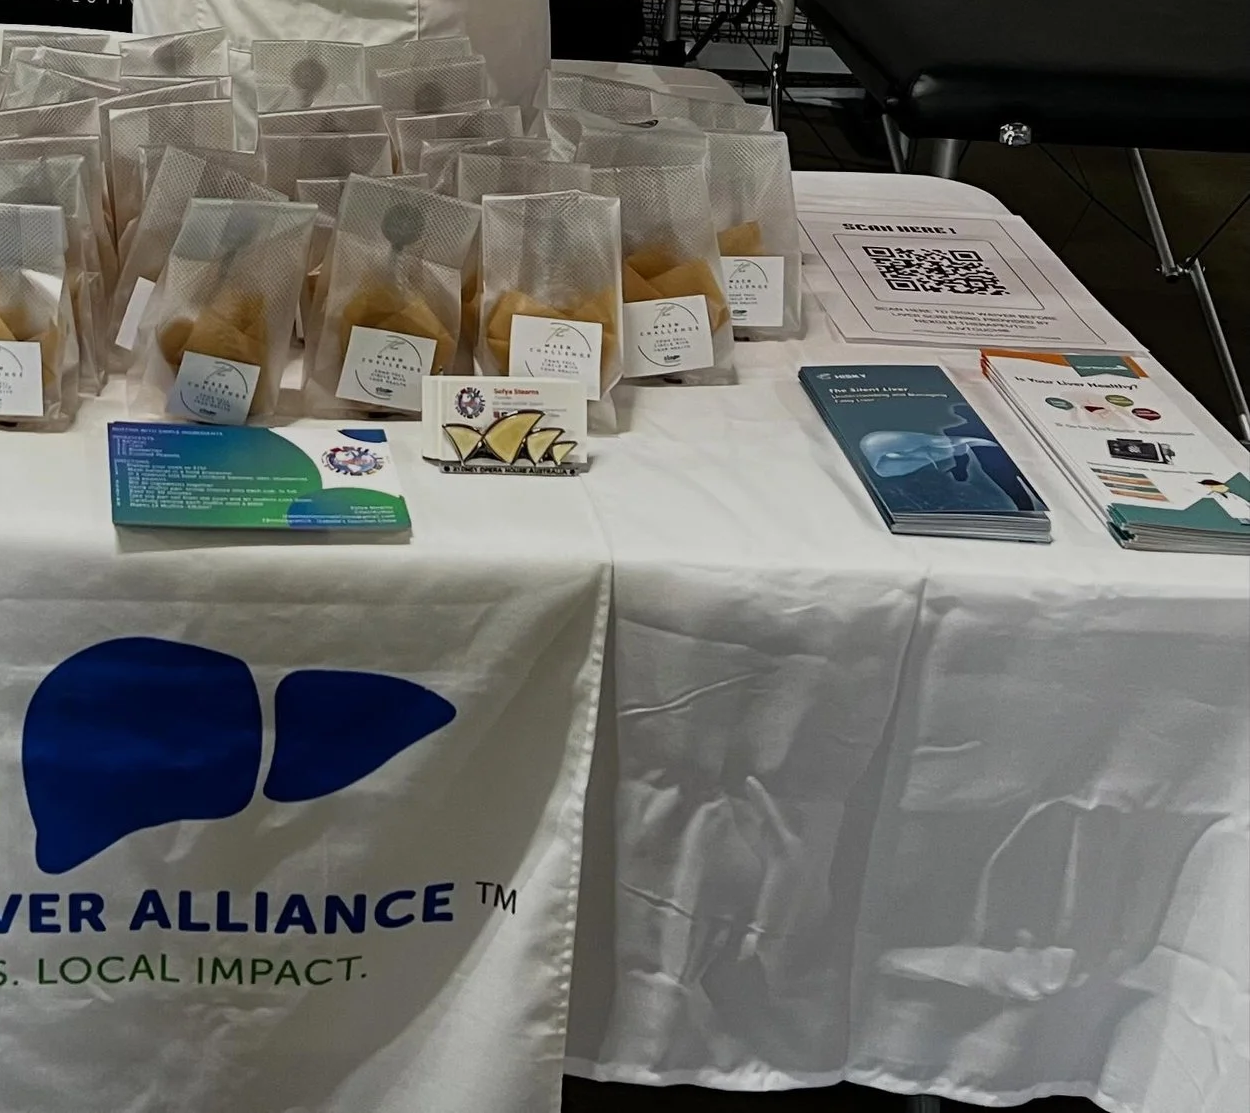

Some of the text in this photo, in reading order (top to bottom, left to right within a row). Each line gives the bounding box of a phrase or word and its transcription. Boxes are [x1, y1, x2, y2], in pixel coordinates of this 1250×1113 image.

[843, 223, 893, 231] SCAN
[1027, 377, 1053, 385] Your
[1087, 382, 1138, 390] Healthy?
[130, 881, 456, 936] ALLIANCE
[475, 881, 518, 916] TM
[38, 953, 181, 988] LOCAL
[195, 955, 368, 988] IMPACT.
